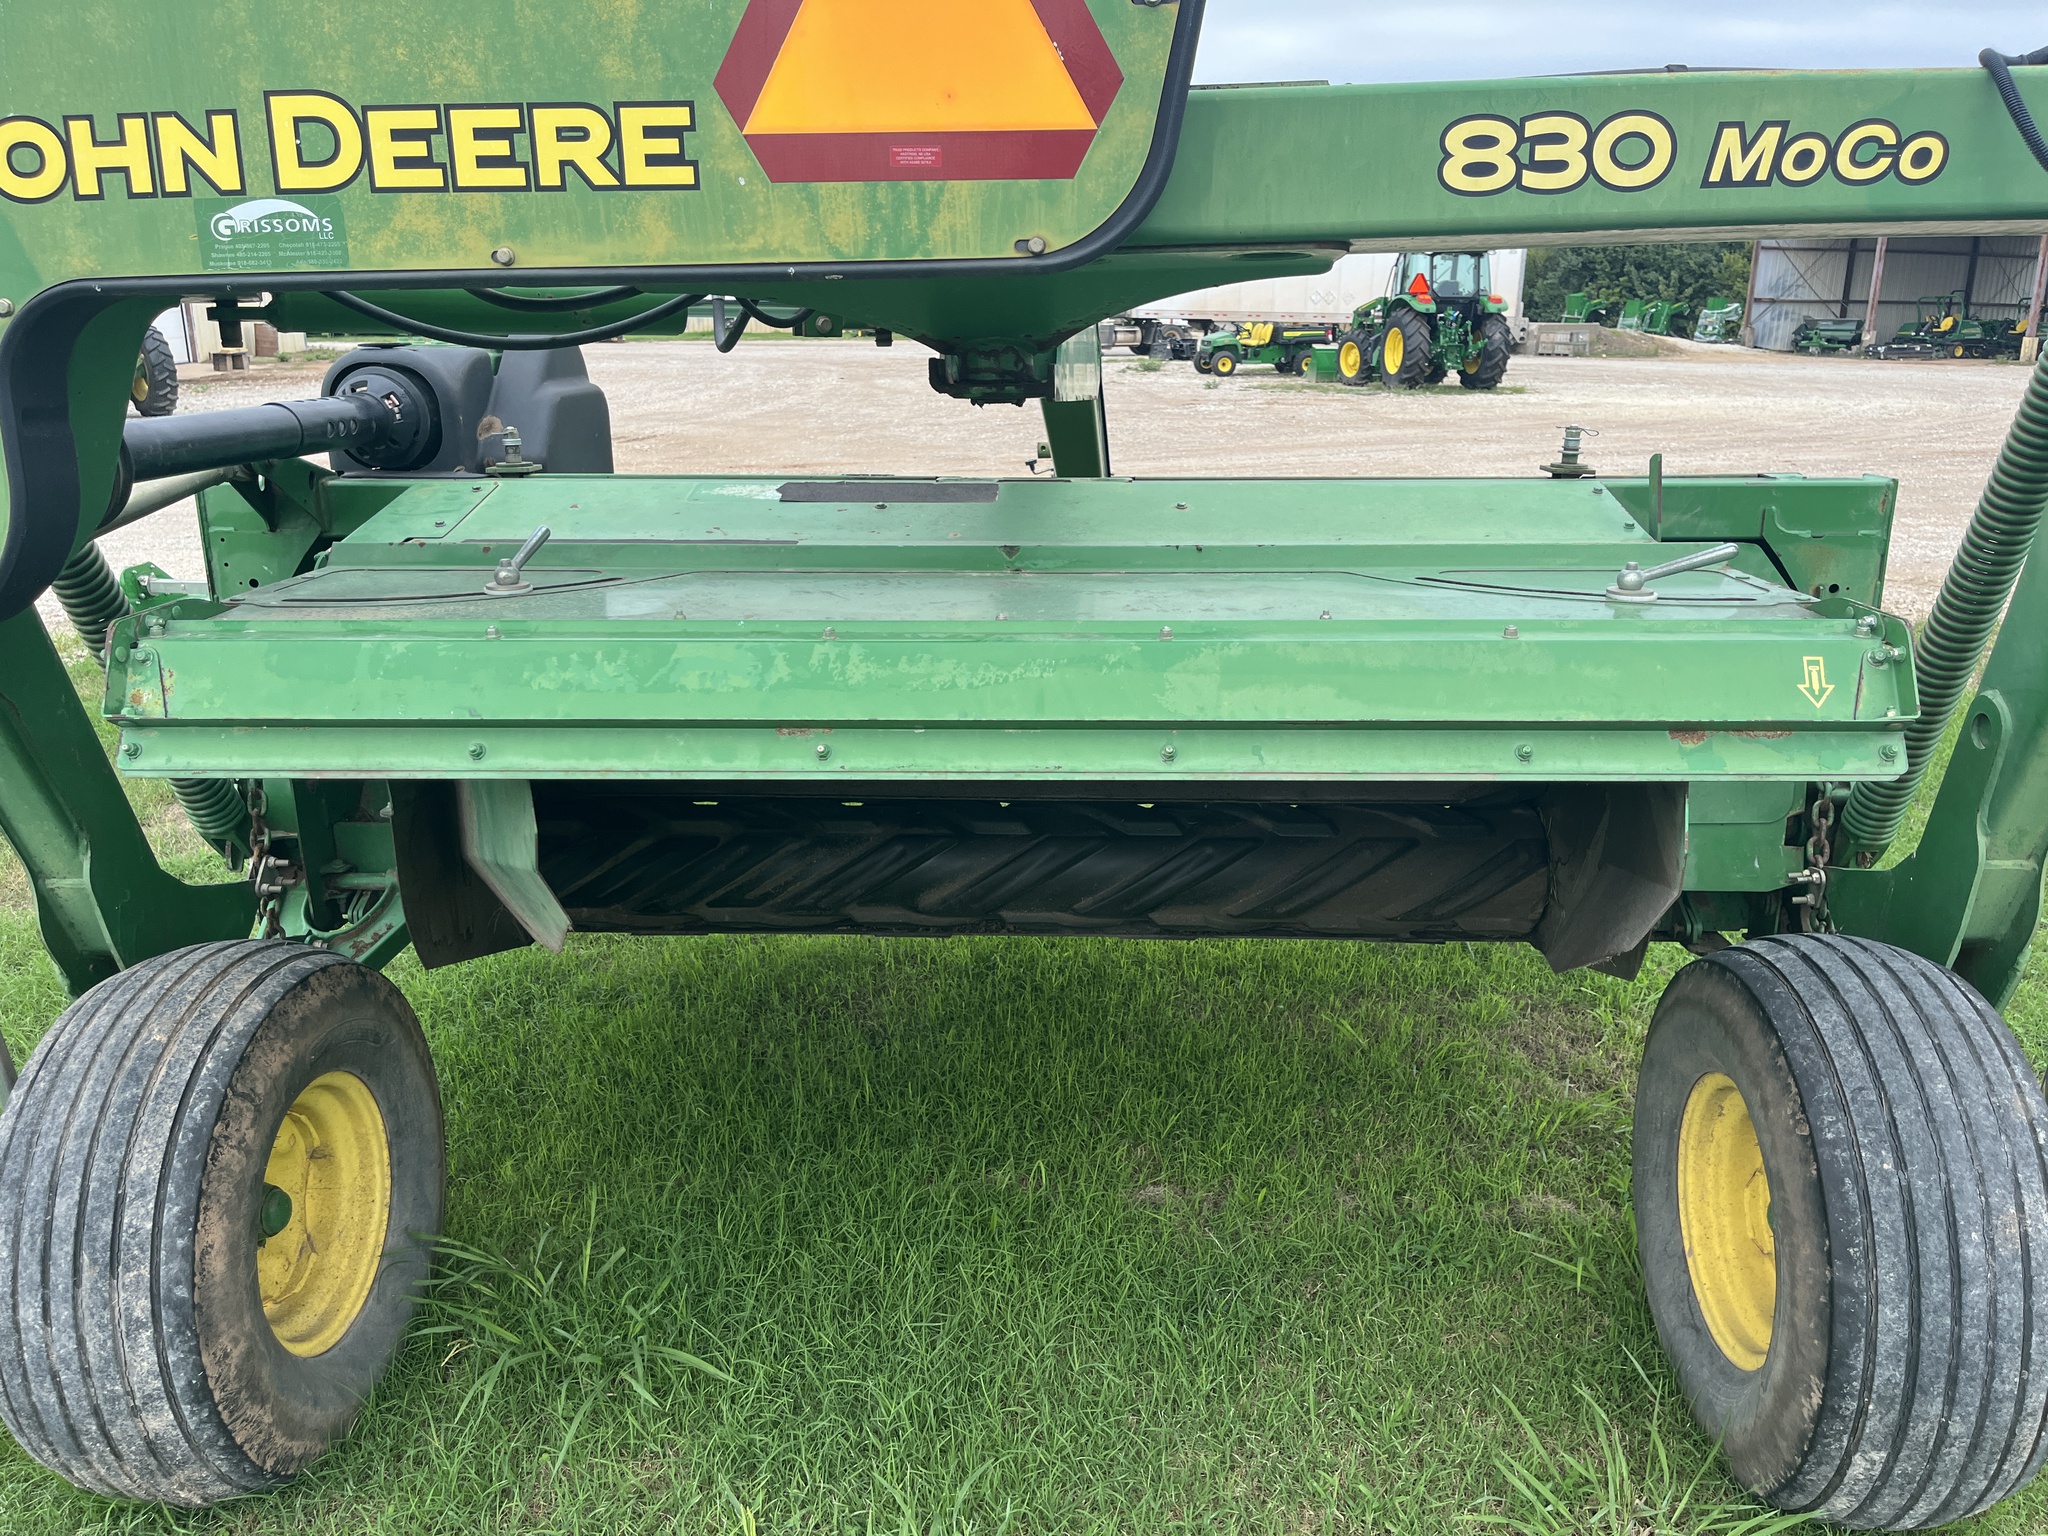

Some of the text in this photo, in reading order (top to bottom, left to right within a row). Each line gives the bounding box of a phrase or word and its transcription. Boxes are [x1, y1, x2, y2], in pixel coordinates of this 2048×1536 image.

[264, 89, 700, 194] DEERE
[1437, 109, 1949, 196] 830 MoCo
[211, 213, 333, 239] GRISSOMS
